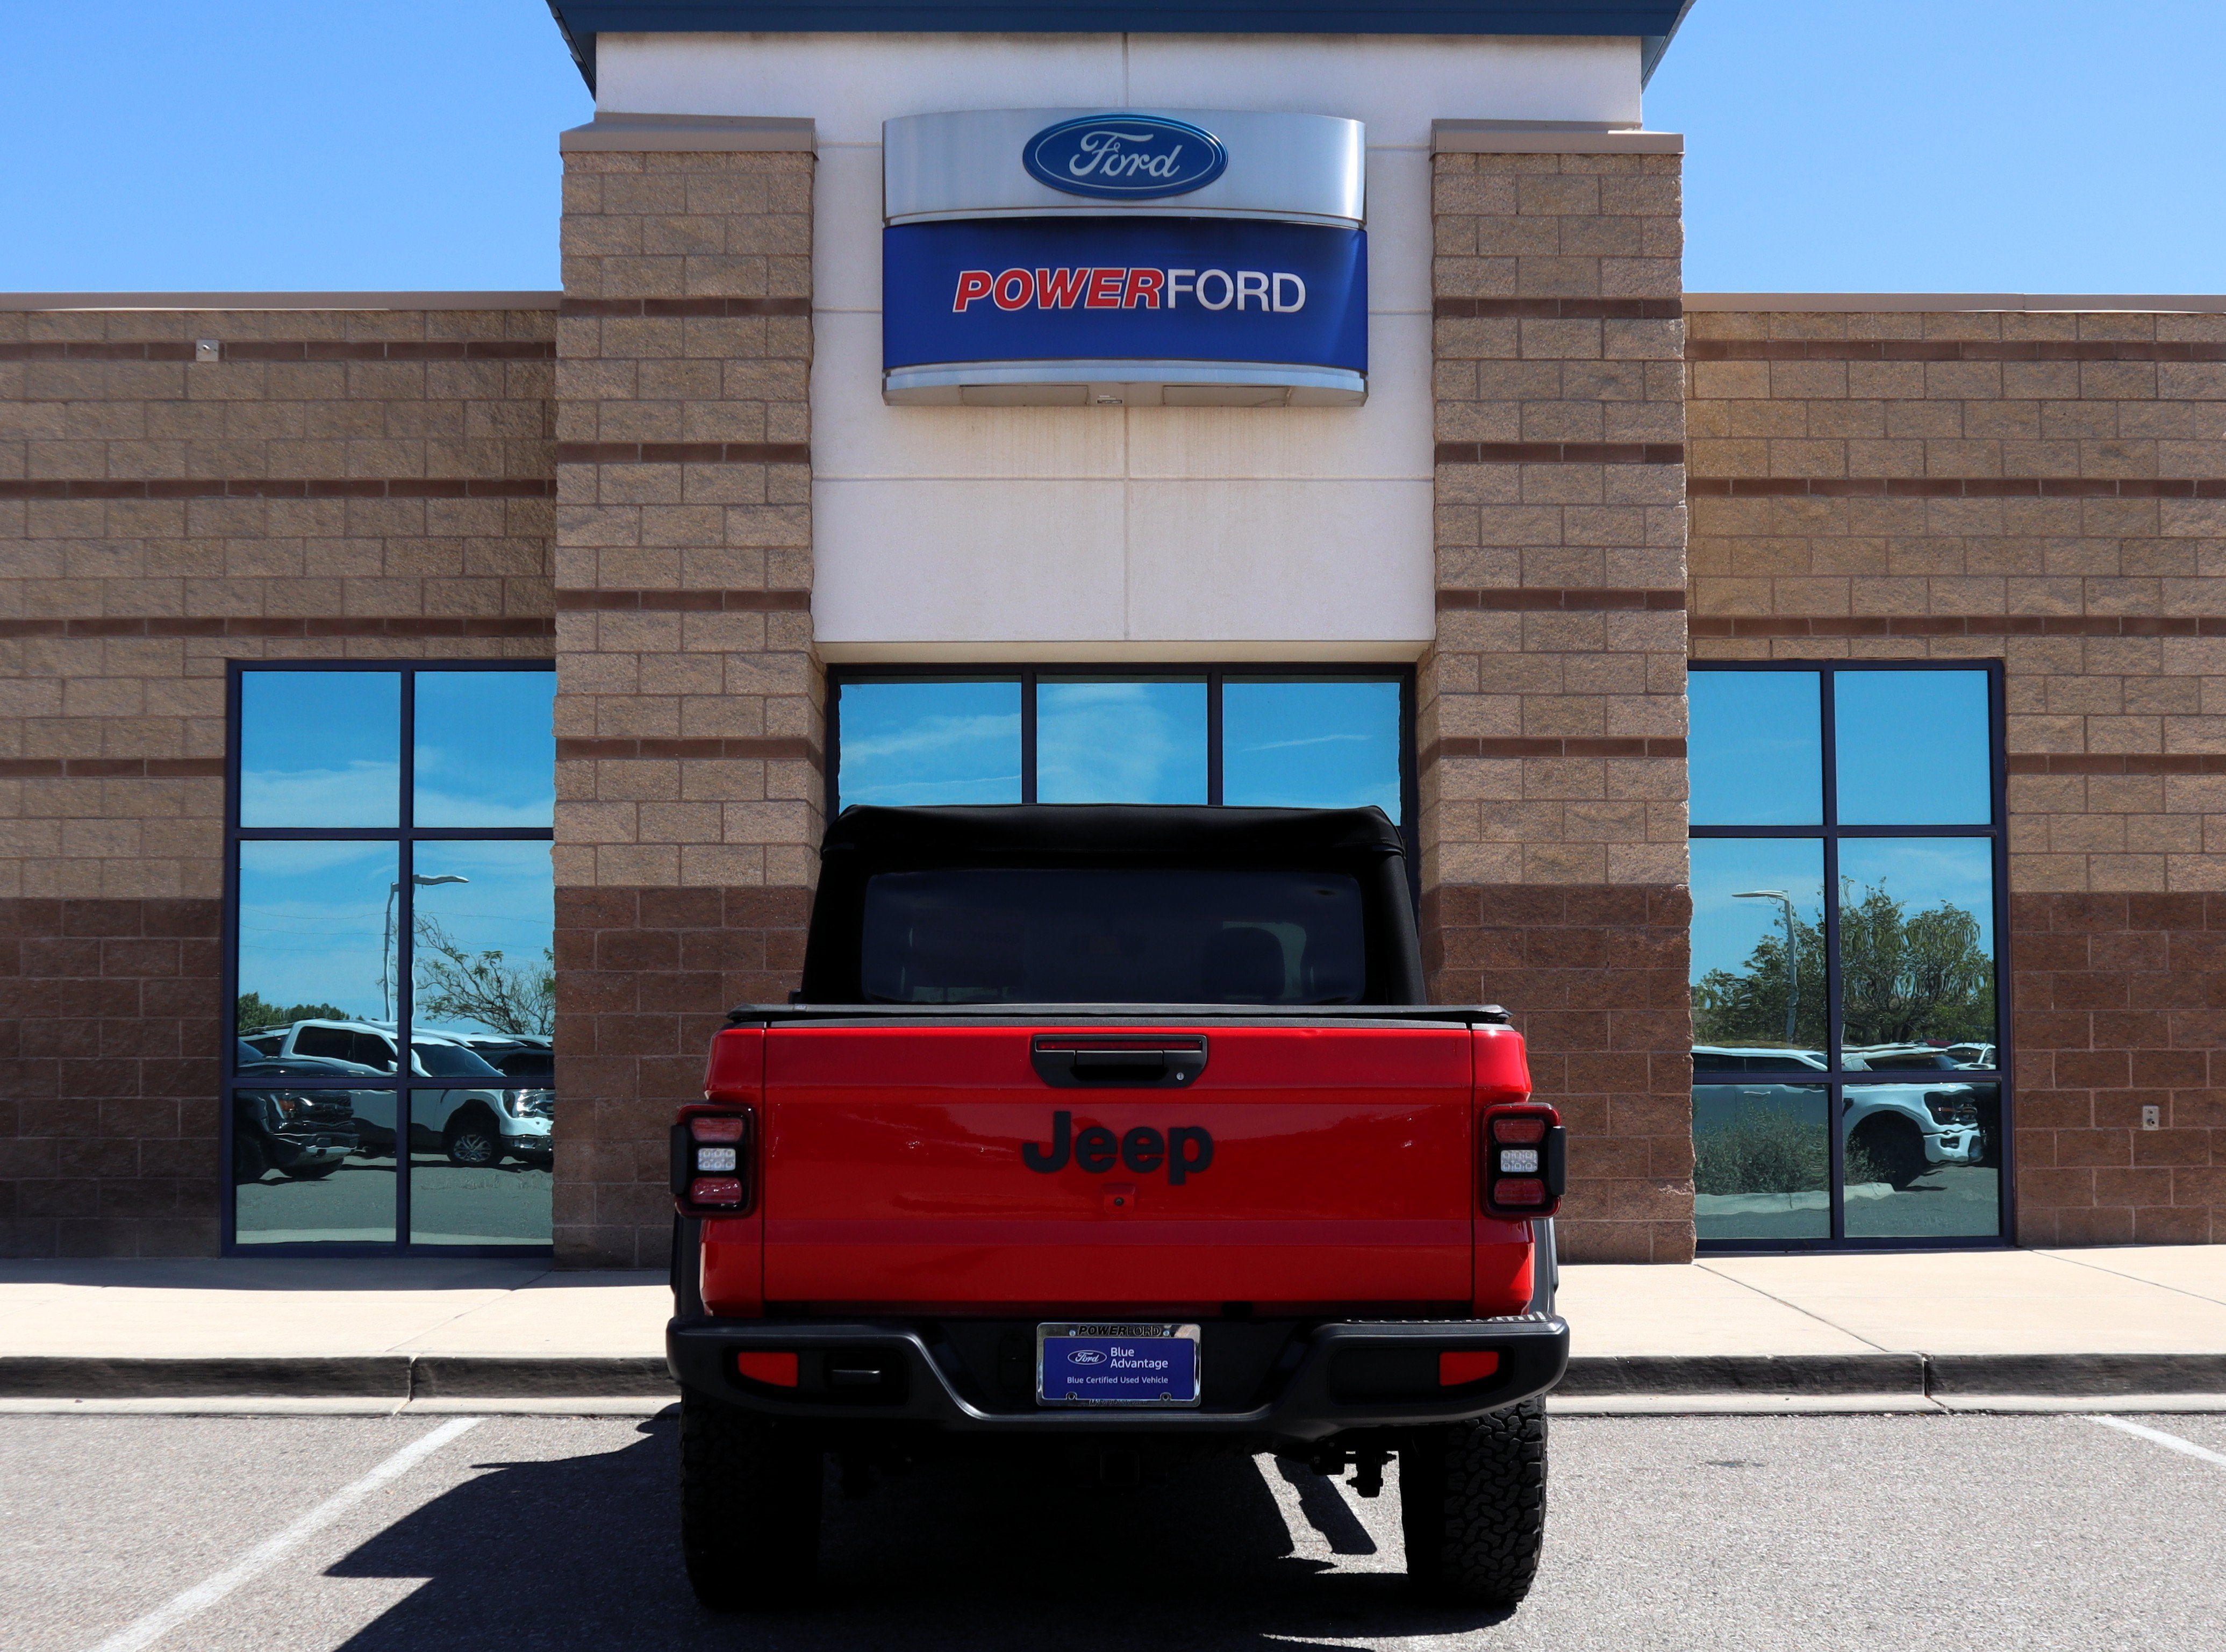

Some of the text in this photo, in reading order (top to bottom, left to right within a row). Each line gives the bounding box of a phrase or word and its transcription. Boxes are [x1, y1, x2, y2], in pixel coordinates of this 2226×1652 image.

[1068, 131, 1183, 178] Ford
[1022, 1110, 1214, 1186] Jeep
[1075, 1351, 1100, 1363] Ford
[1110, 1347, 1135, 1357] Blue
[1110, 1358, 1169, 1370] Advantage
